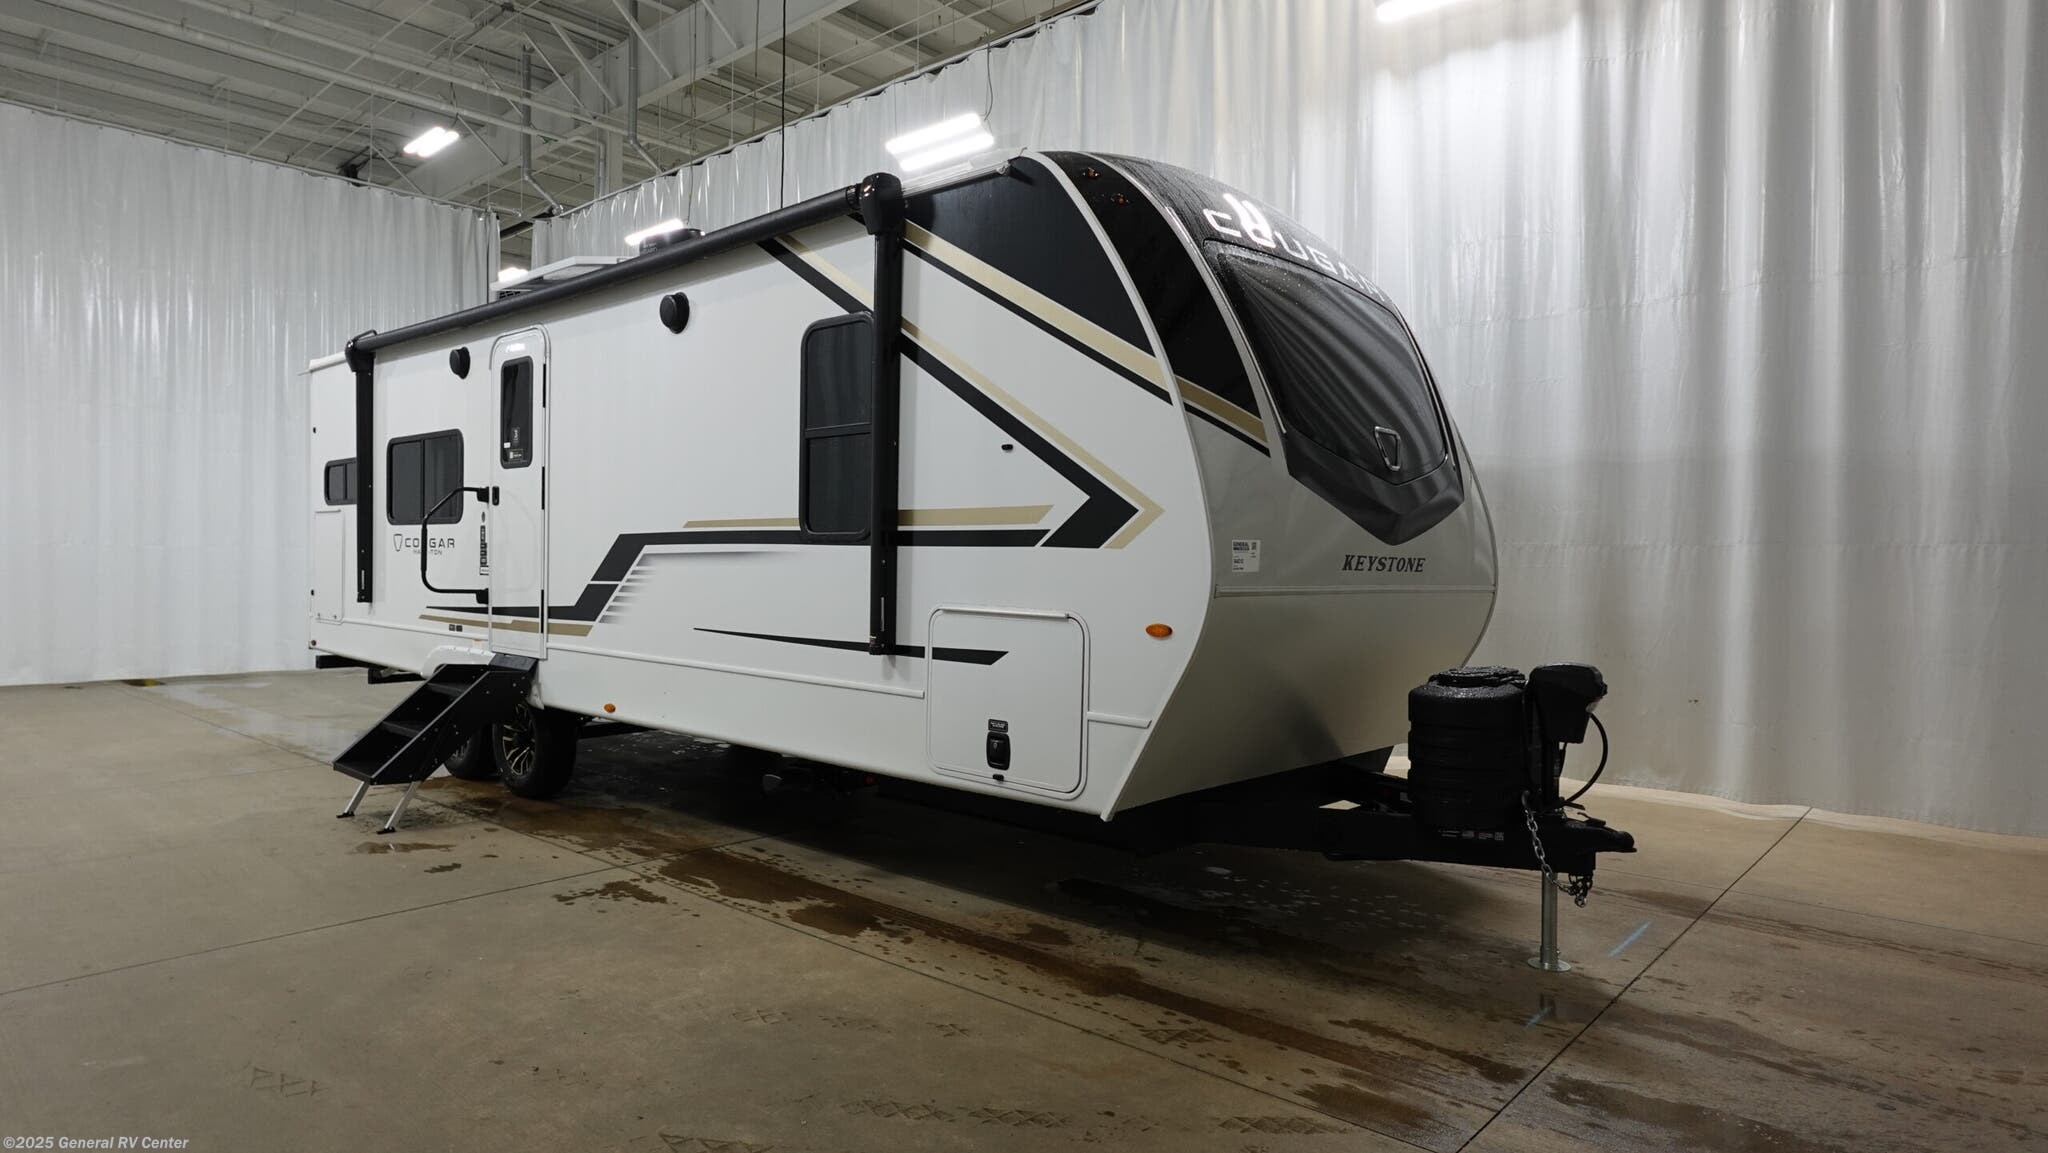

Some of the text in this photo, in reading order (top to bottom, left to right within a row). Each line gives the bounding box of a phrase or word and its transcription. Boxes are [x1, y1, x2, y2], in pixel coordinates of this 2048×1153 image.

[1203, 193, 1385, 301] COUGAR
[405, 538, 455, 548] COGAR
[1341, 555, 1426, 572] KEYSTONE
